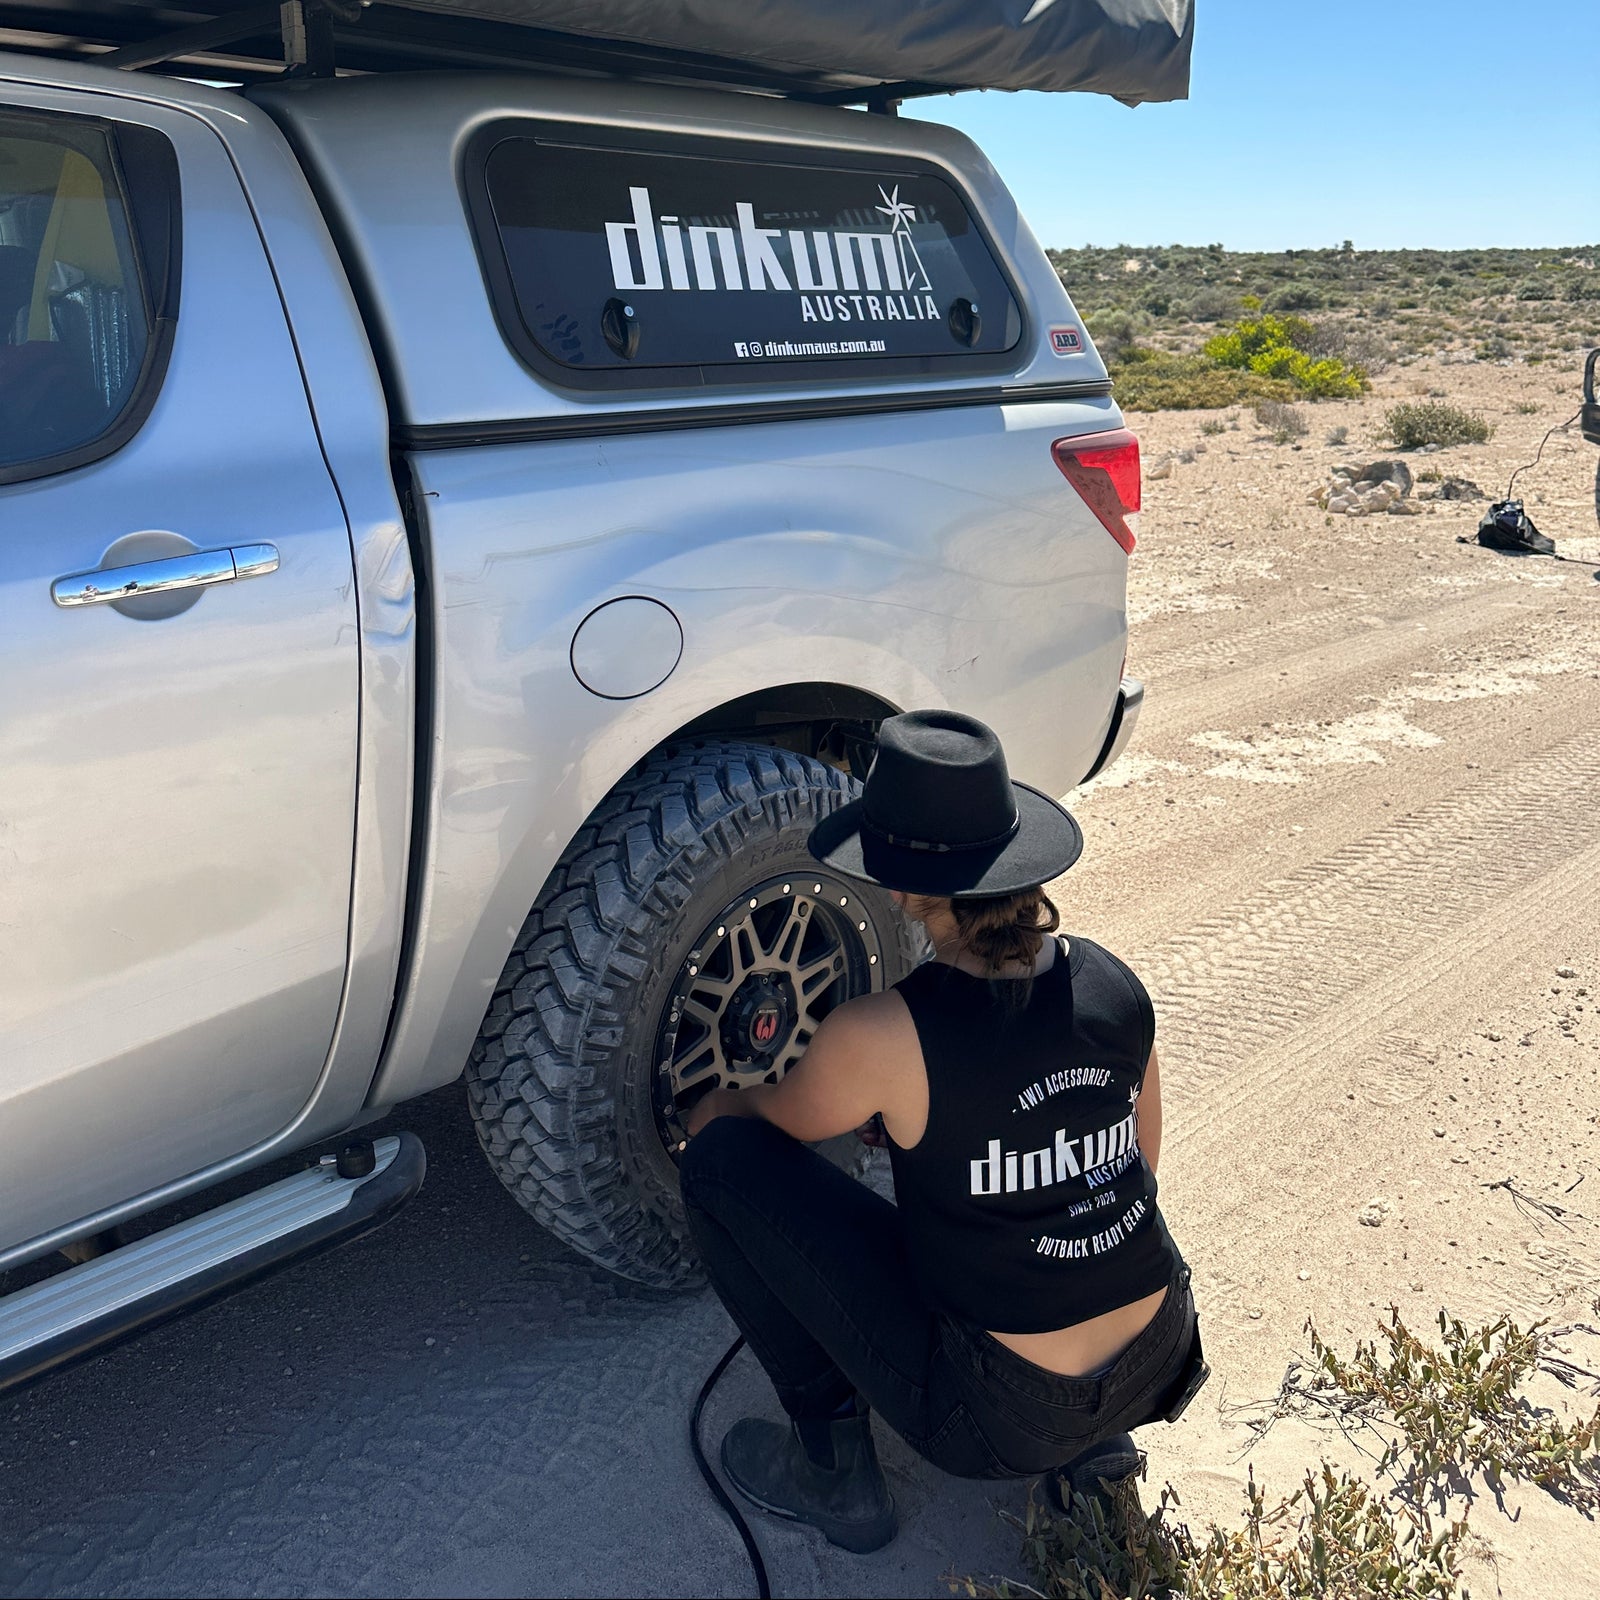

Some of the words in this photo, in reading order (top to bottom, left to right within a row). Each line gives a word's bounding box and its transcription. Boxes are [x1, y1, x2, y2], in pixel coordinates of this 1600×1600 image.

[604, 186, 905, 291] dinkum
[801, 295, 941, 322] AUSTRALIA
[765, 339, 886, 357] dinkumaus.com.au
[1055, 334, 1079, 348] ARB
[1017, 1083, 1046, 1112] 4WD
[1044, 1067, 1111, 1097] ACCESSORIES
[970, 1113, 1136, 1196] dinkum
[1068, 1198, 1093, 1218] SINCE
[1094, 1190, 1116, 1209] 2020
[1036, 1235, 1090, 1259] OUTBACK
[1091, 1226, 1126, 1256] READY
[1122, 1200, 1147, 1233] GEAR
